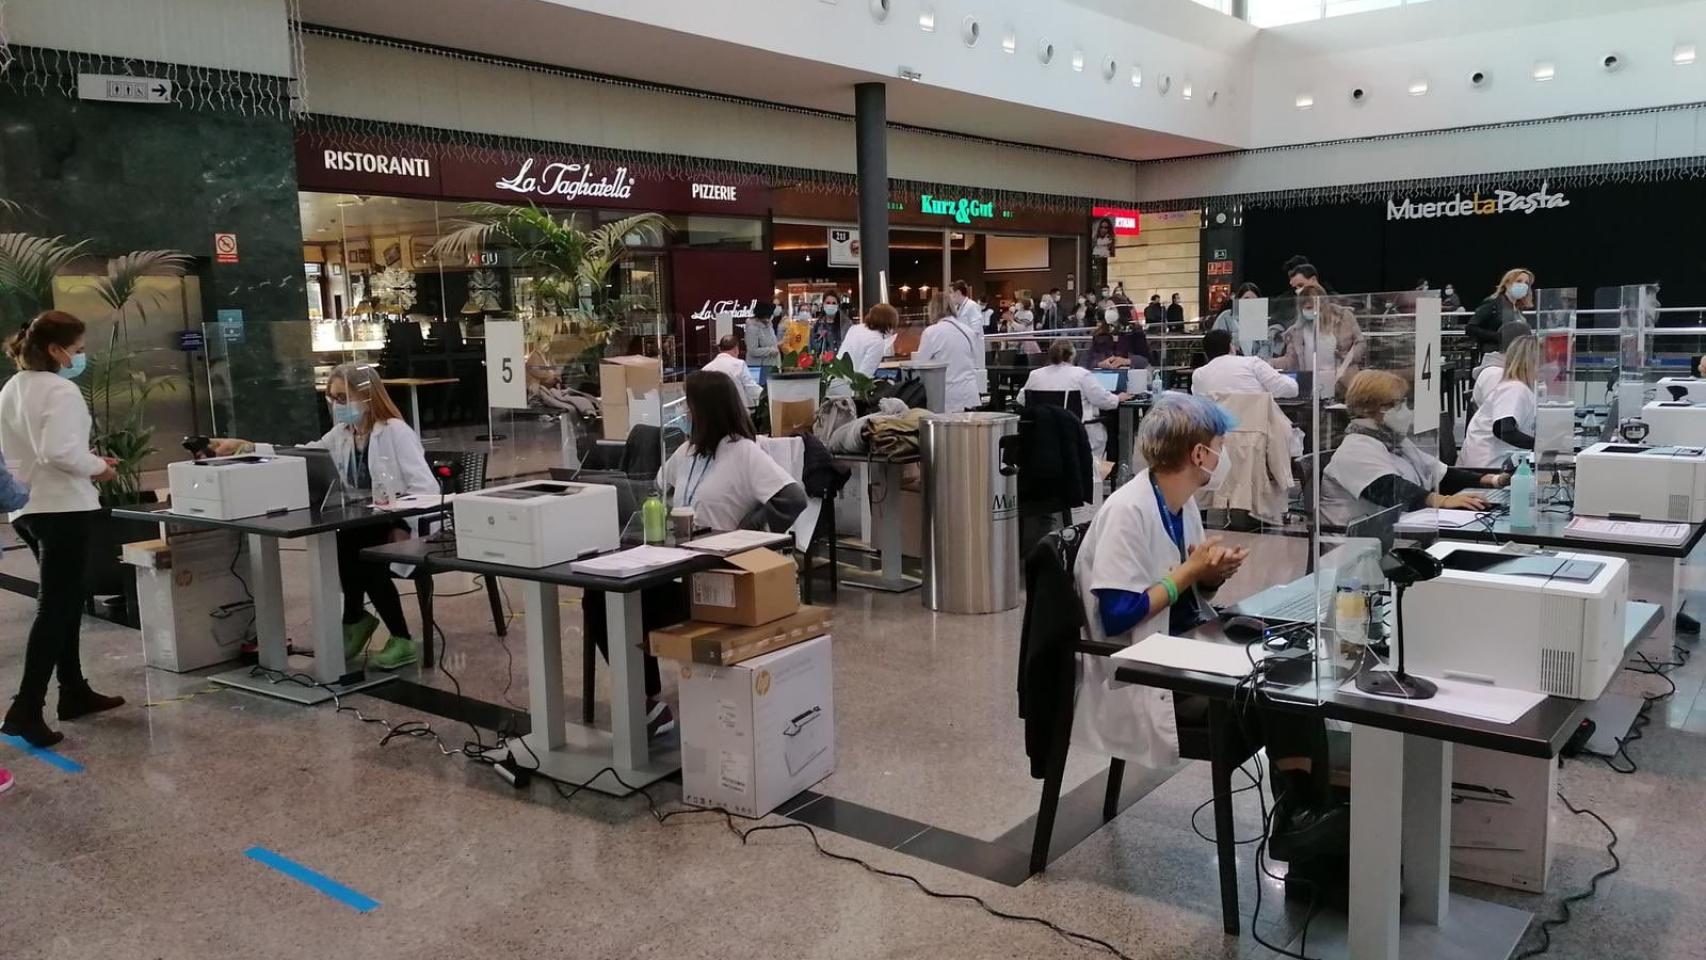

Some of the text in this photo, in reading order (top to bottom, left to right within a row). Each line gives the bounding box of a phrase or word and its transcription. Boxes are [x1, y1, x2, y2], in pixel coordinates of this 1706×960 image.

[324, 149, 430, 178] RISTORANTI
[495, 158, 632, 200] La Tagliatella
[692, 183, 737, 201] PIZZERIE
[921, 194, 993, 224] Kurz&Gut
[691, 299, 712, 320] La
[502, 357, 513, 384] 5
[1421, 342, 1432, 391] 4
